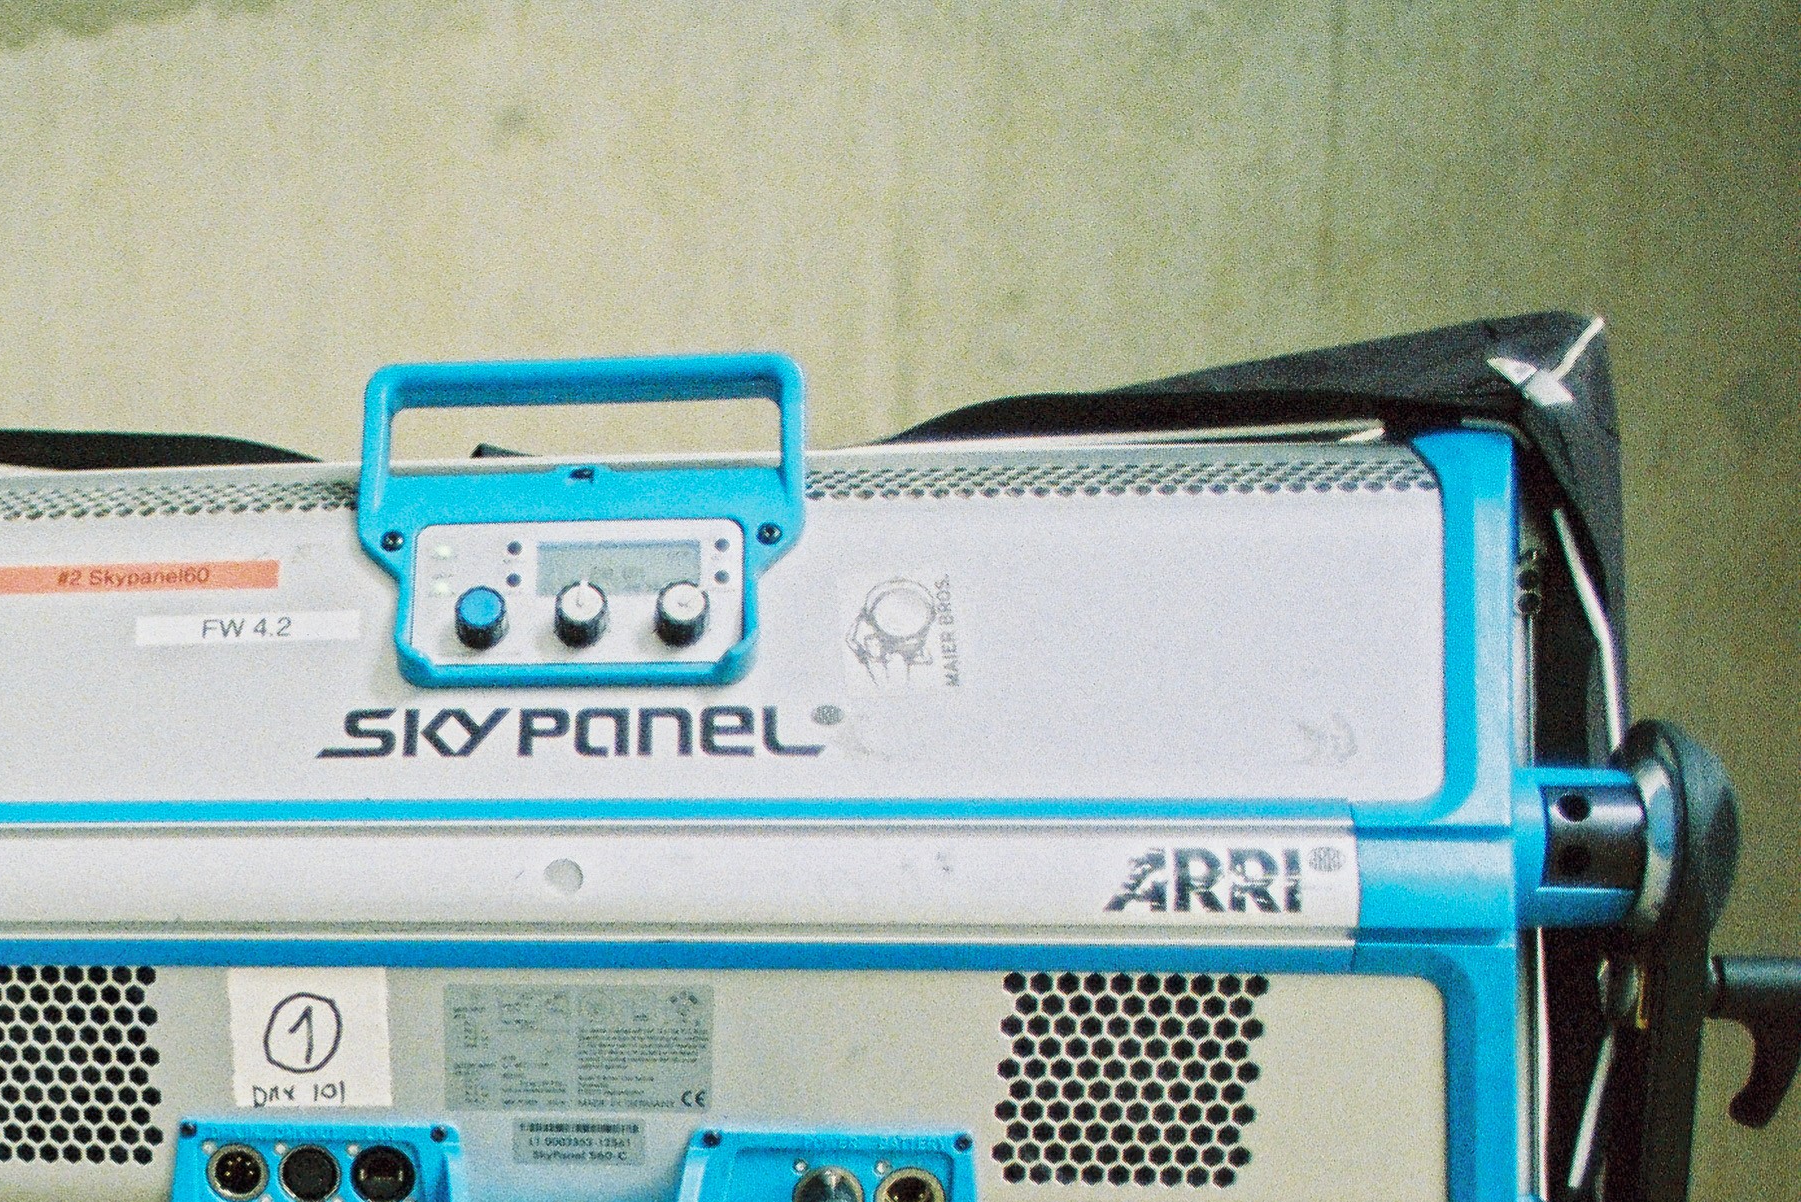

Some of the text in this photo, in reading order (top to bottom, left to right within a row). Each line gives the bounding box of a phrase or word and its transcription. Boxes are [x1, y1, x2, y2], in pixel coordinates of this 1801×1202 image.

[55, 565, 211, 589] #2 Skypanel60
[201, 615, 293, 640] FW 4.2
[1102, 847, 1303, 914] ARRI
[312, 1079, 346, 1105] 101
